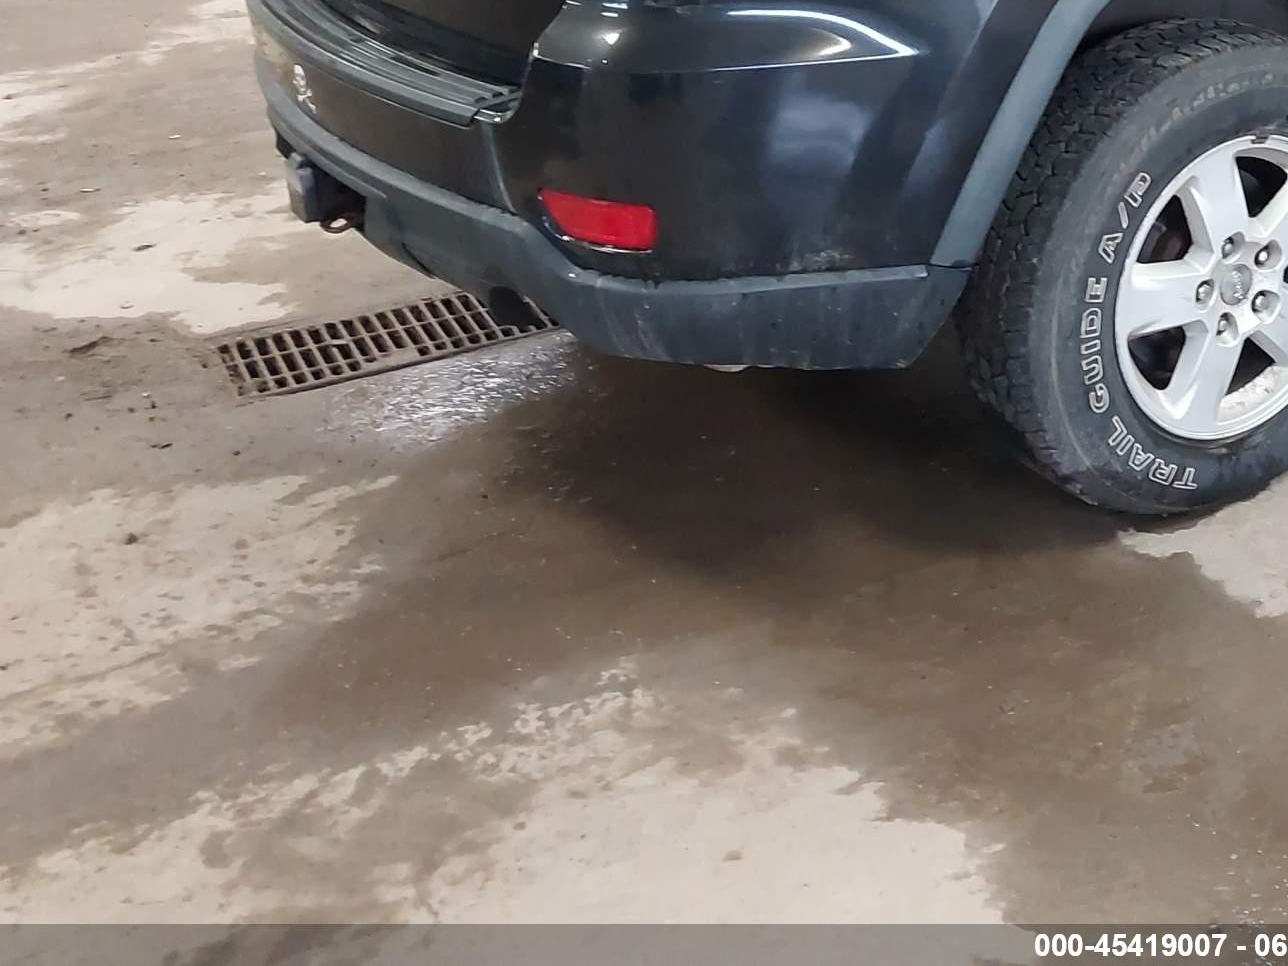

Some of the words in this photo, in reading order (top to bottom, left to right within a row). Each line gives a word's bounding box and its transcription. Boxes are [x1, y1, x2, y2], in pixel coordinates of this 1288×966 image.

[1098, 172, 1152, 264] A/P
[1080, 277, 1111, 413] GUIDE
[1107, 416, 1199, 490] TRAIL
